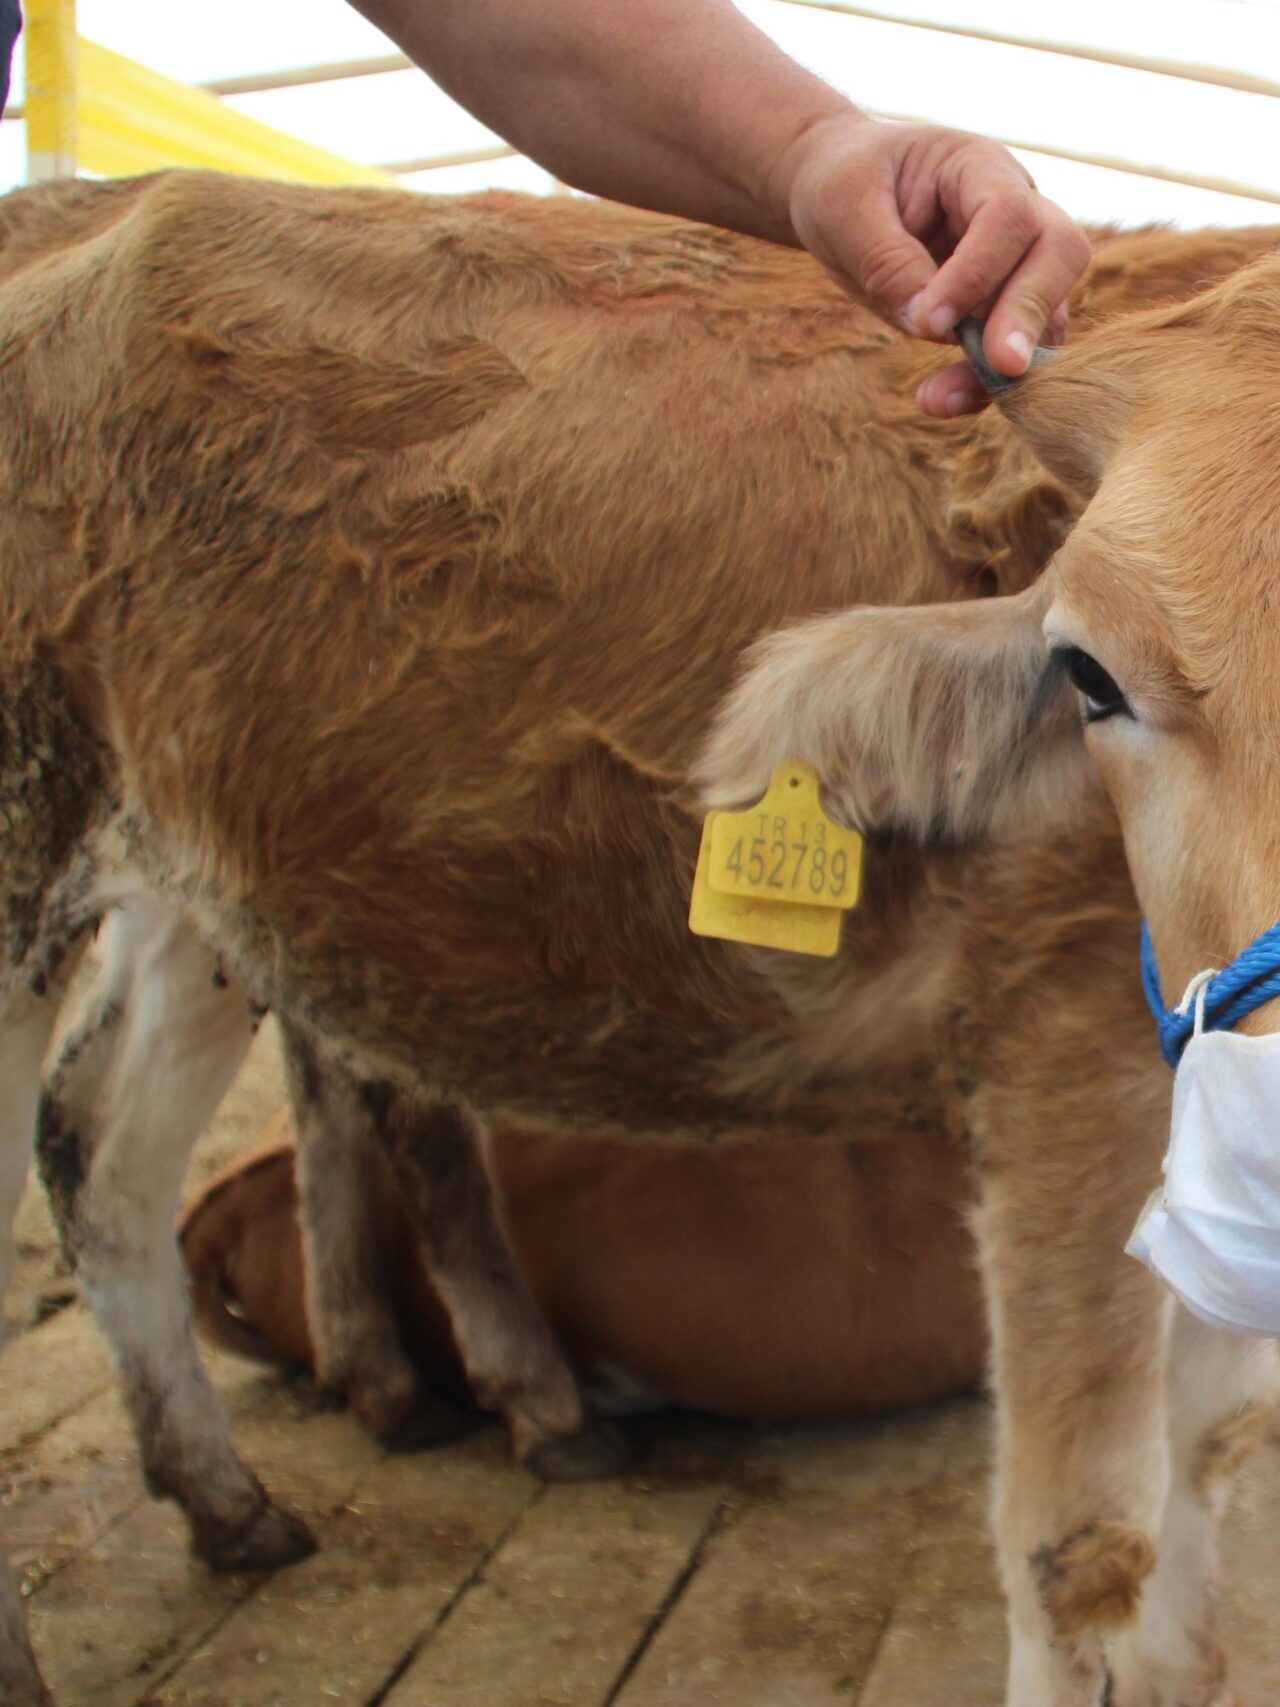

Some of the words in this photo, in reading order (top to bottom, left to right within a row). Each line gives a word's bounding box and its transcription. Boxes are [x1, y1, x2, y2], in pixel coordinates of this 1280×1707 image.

[757, 814, 786, 837] TR
[799, 821, 826, 844] 13
[726, 836, 848, 896] 452789
